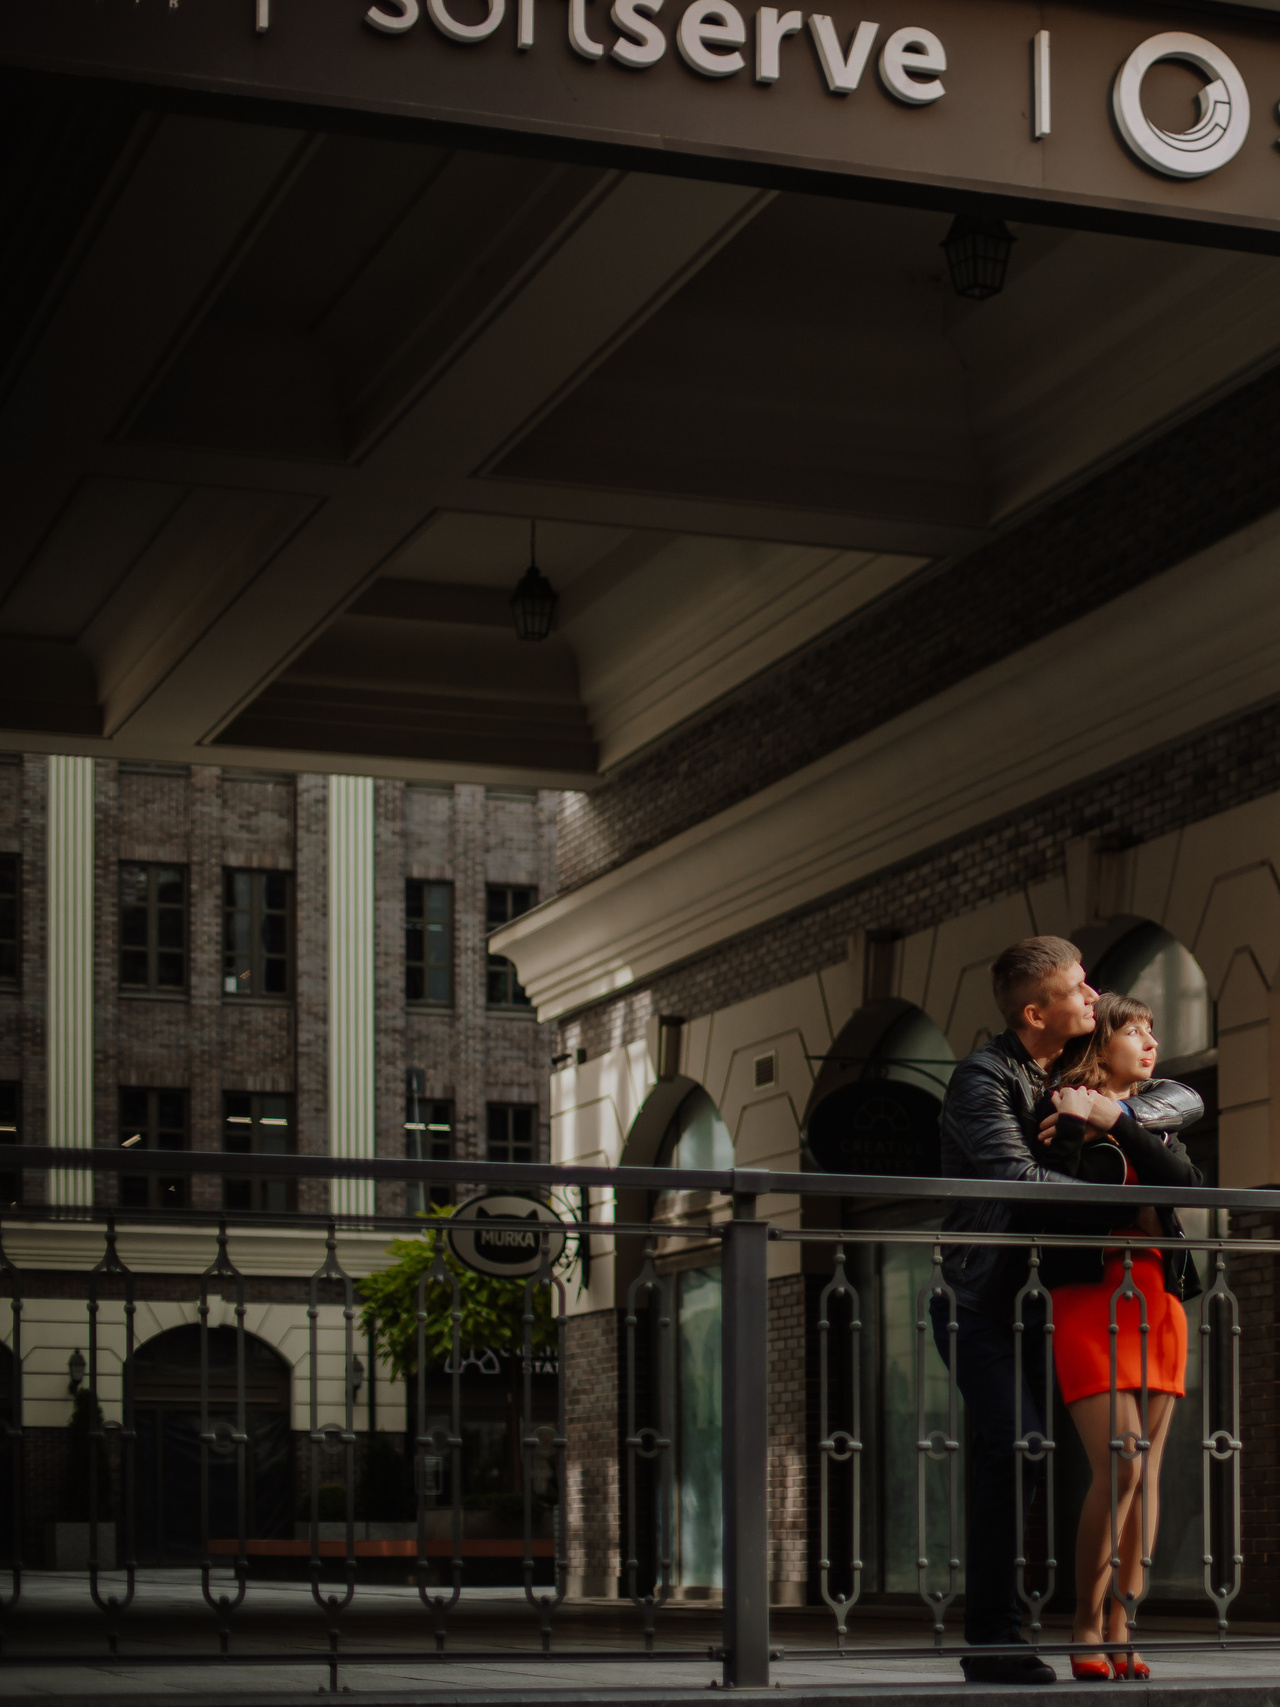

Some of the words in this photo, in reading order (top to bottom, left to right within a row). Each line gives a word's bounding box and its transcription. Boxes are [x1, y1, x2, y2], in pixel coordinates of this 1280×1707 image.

[840, 1139, 925, 1155] CREATIVE
[850, 1157, 916, 1173] STATES
[481, 1230, 536, 1248] MURKA
